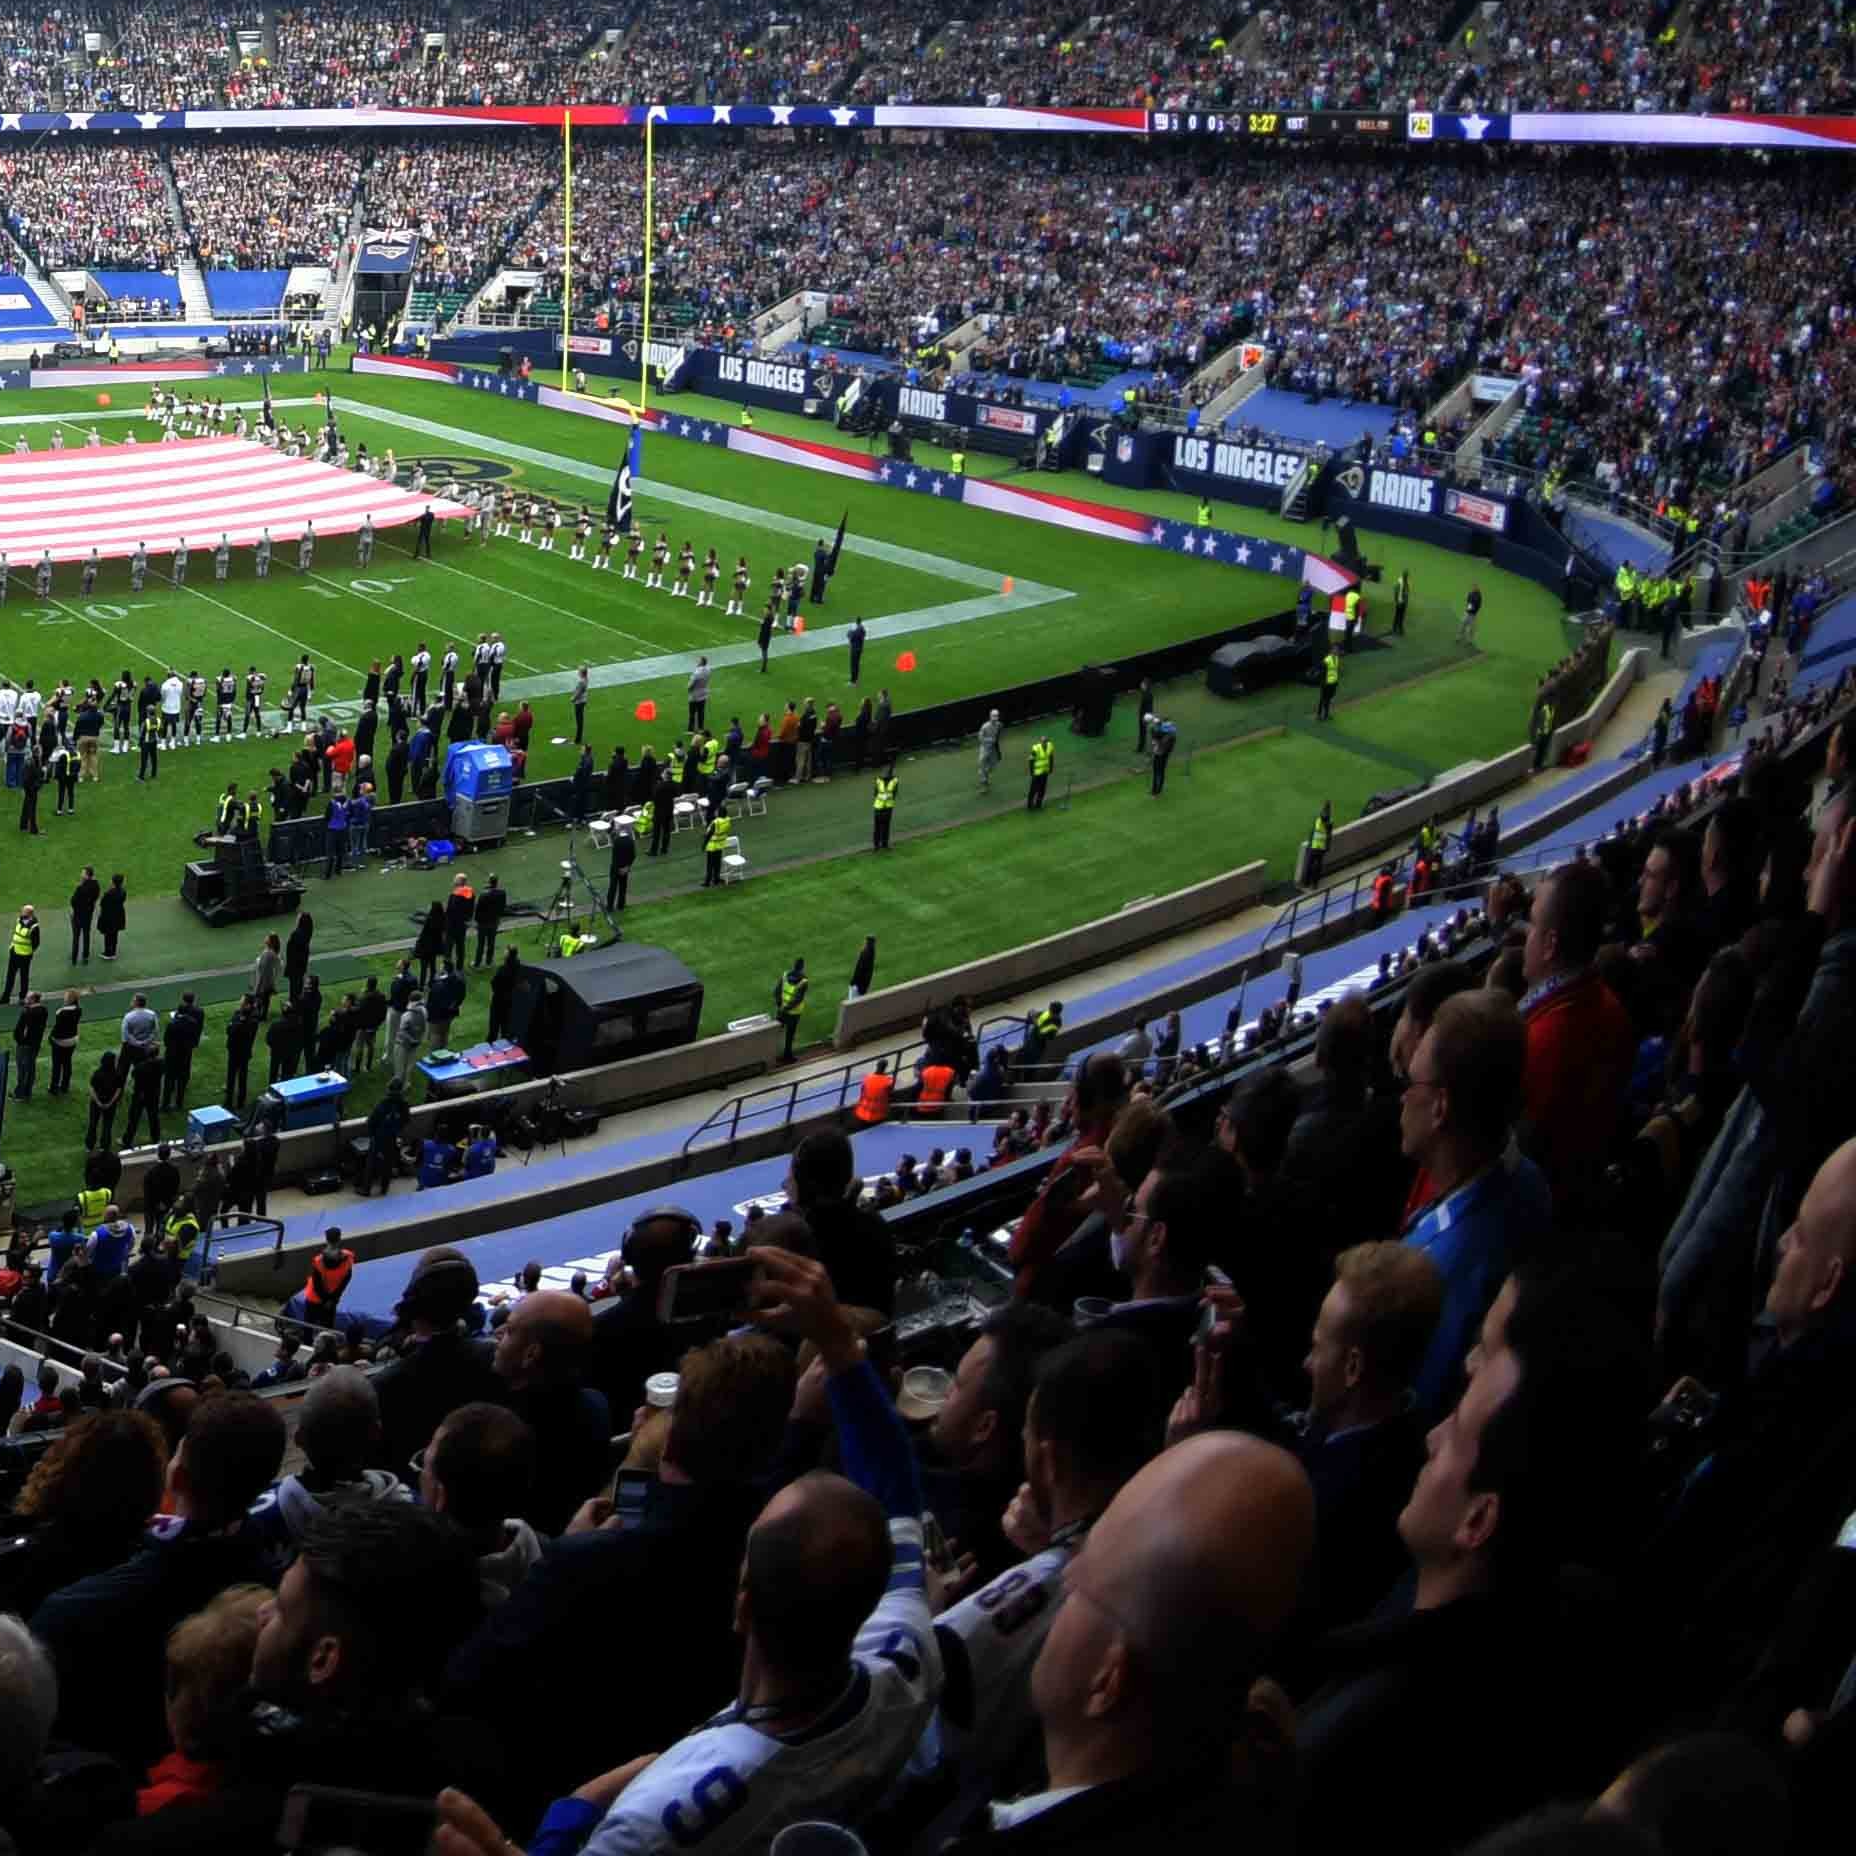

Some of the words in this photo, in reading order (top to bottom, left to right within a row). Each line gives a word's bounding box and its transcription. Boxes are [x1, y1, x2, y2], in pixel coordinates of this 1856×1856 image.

[1248, 114, 1277, 132] 3:27
[719, 356, 742, 382] LOS
[746, 358, 806, 393] ANGELES
[899, 387, 945, 421] RAMS
[1174, 436, 1209, 470] LOS
[1213, 444, 1299, 486] ANGELES
[1370, 471, 1433, 513] RAMS
